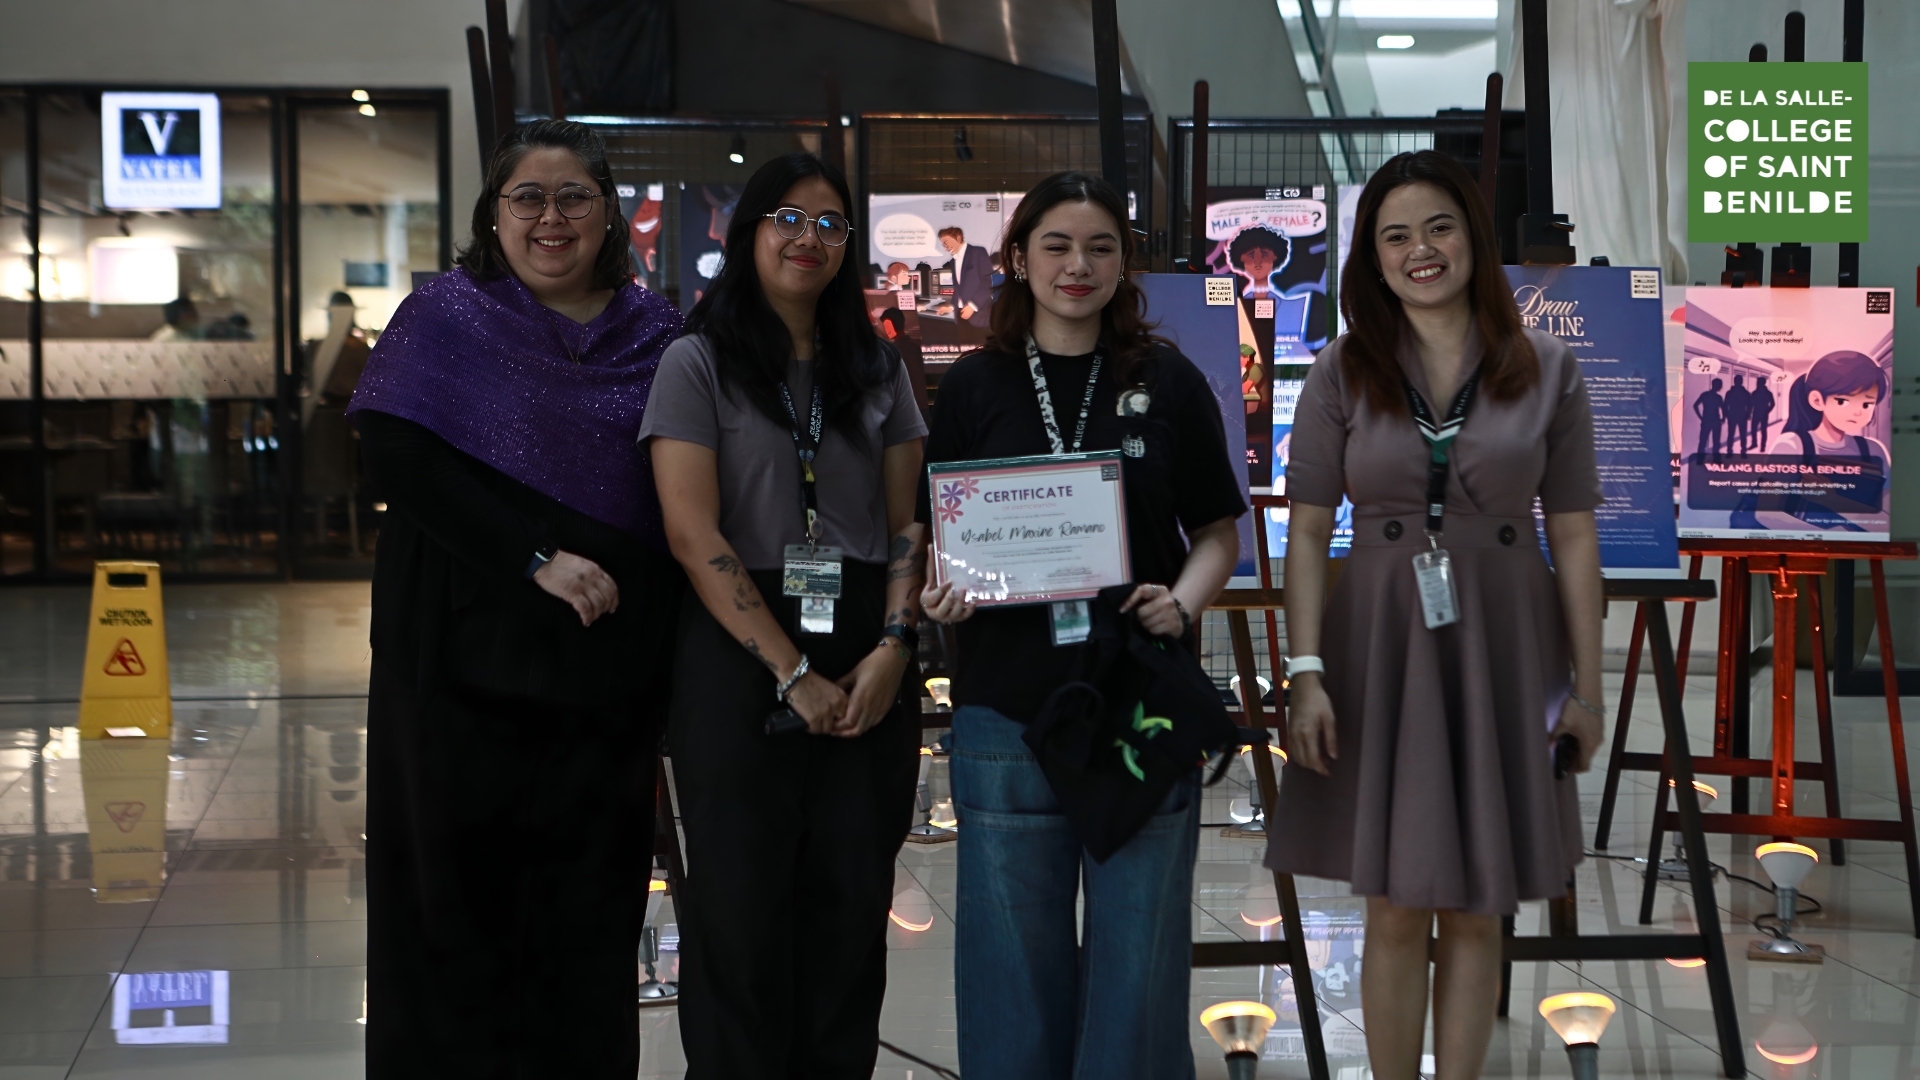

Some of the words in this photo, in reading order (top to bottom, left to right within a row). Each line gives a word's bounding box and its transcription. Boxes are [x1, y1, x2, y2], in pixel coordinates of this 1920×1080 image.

[137, 111, 179, 156] V
[1211, 217, 1241, 234] MALE
[1513, 284, 1579, 317] Draw
[1548, 316, 1585, 337] LINE
[1087, 354, 1104, 384] BENILDE
[1083, 385, 1095, 407] SAINT
[1704, 463, 1753, 473] WALANG
[1755, 464, 1798, 474] BASTOS
[1799, 465, 1814, 474] SA
[1817, 465, 1862, 475] BENILDE
[984, 485, 1074, 503] CERTIFICATE
[1709, 480, 1731, 488] Report
